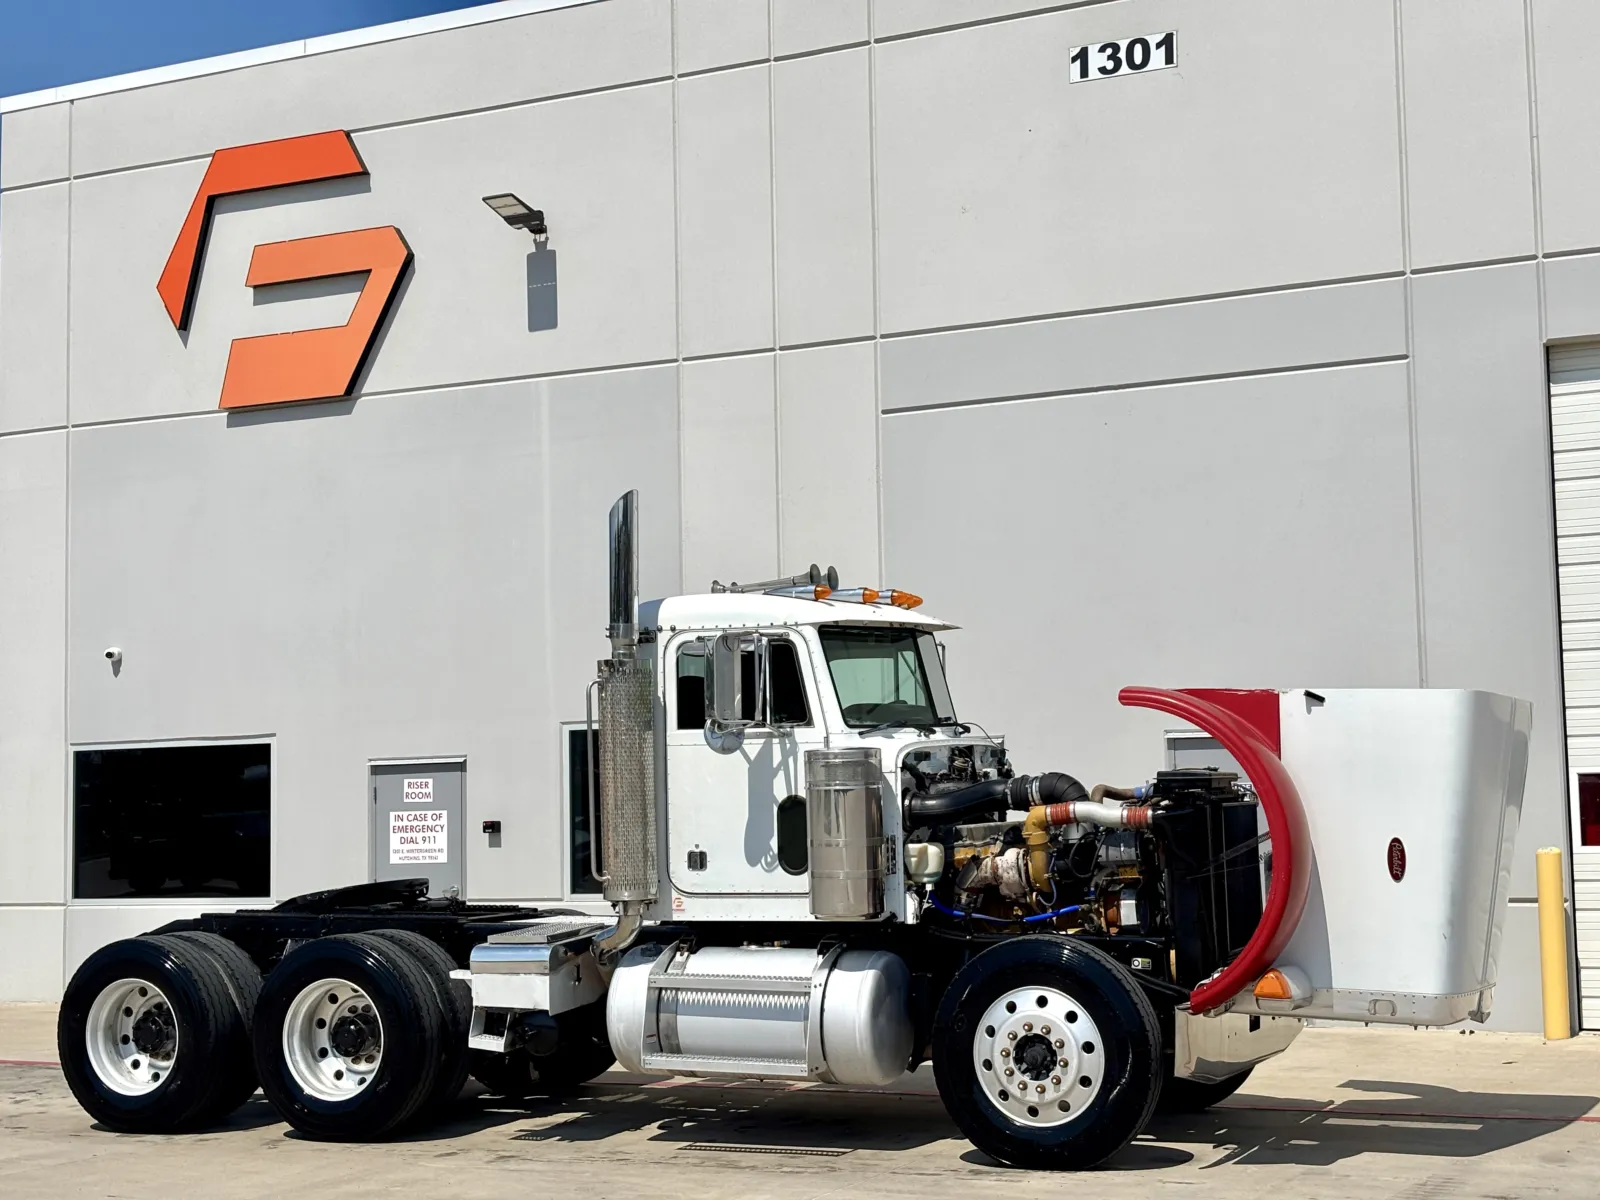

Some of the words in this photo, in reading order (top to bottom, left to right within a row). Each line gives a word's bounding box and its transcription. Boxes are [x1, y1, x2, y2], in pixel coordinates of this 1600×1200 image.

[1070, 32, 1174, 79] 1301
[407, 781, 429, 790] RISER
[405, 791, 431, 800] ROOM
[394, 814, 404, 822] IN
[406, 813, 428, 822] CASE
[430, 812, 443, 821] OF
[392, 824, 445, 833] EMERGENCY
[399, 836, 419, 844] DIAL
[421, 835, 436, 844] 911
[1391, 842, 1402, 878] Peterbilt
